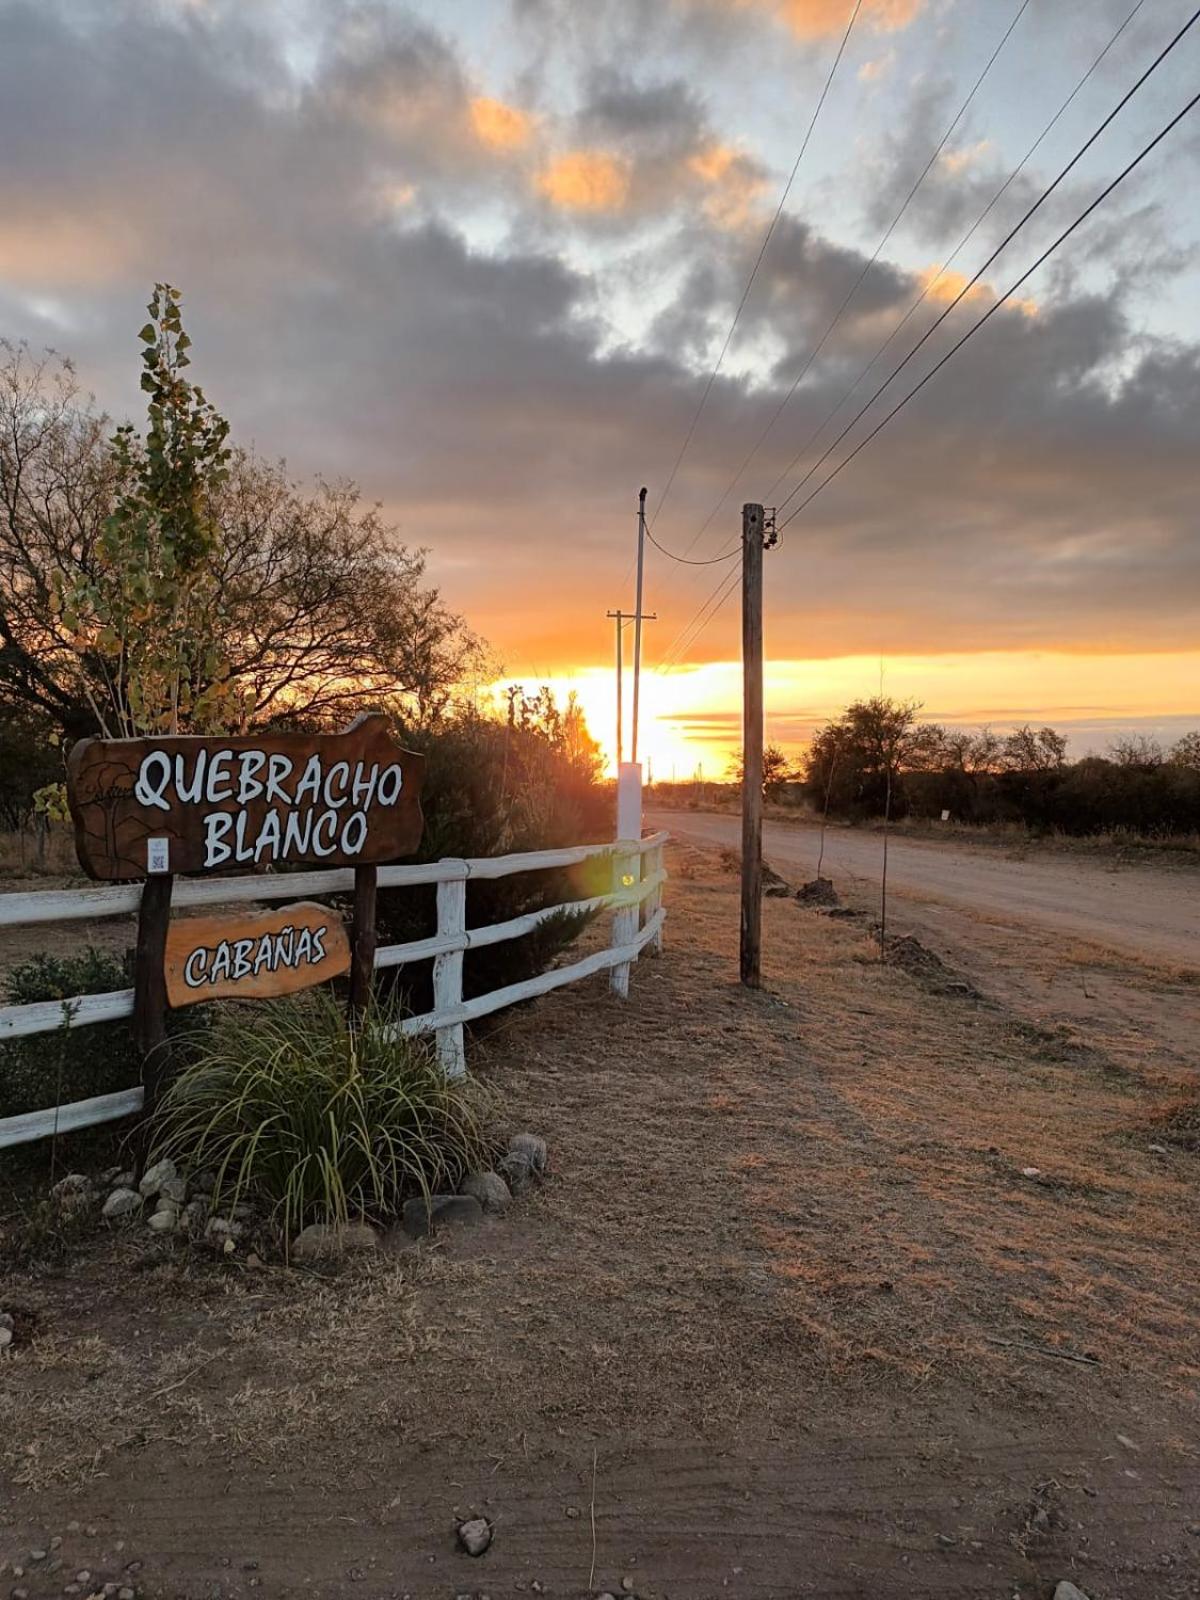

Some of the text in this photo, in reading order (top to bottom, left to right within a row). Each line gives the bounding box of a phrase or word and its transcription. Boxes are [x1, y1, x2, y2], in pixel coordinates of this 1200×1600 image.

[135, 749, 403, 811] QUEBRACHO
[203, 808, 368, 868] BLANCO
[185, 926, 327, 987] CABAÑAS
